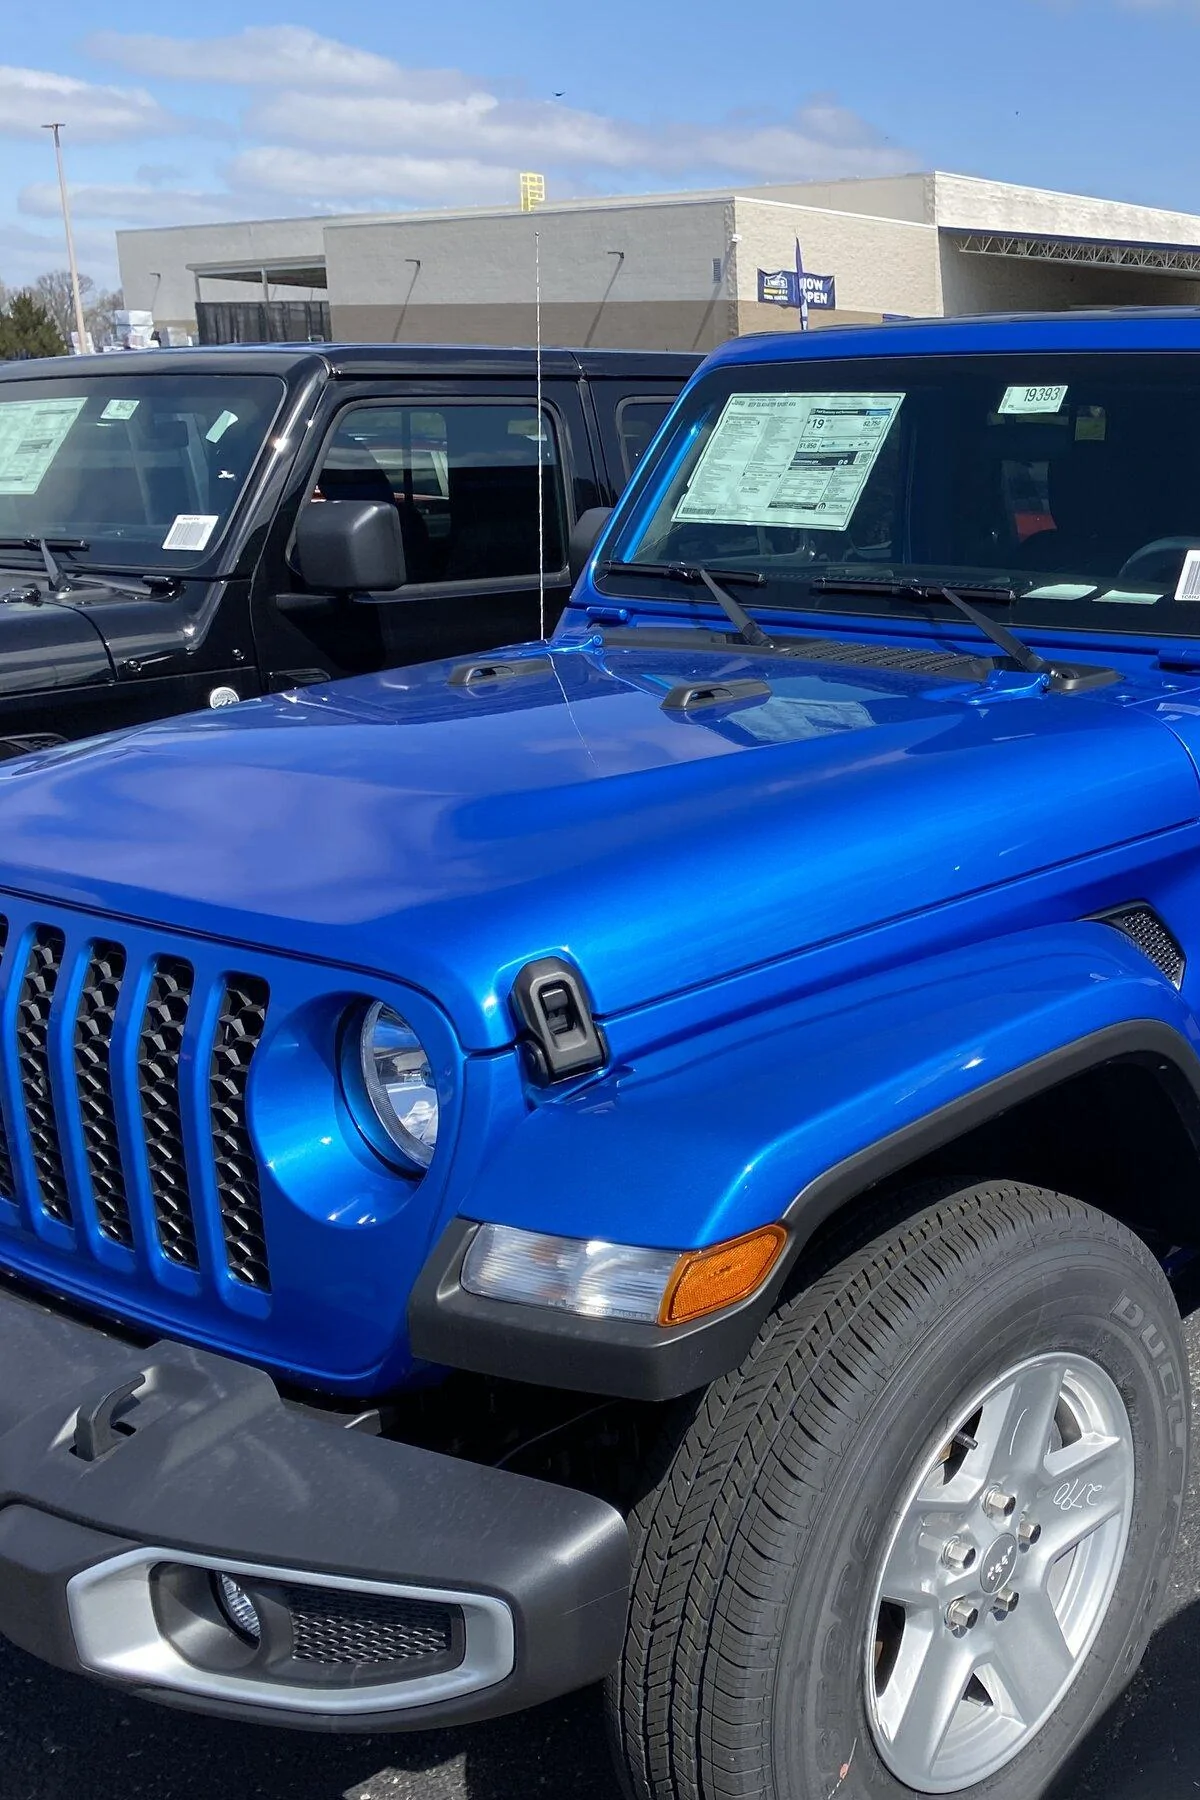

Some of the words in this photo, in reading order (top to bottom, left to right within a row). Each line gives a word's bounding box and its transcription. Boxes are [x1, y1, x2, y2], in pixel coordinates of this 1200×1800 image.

[800, 278, 823, 291] NOW
[803, 291, 828, 304] PEN
[1023, 387, 1061, 402] 19393
[811, 418, 825, 429] 19
